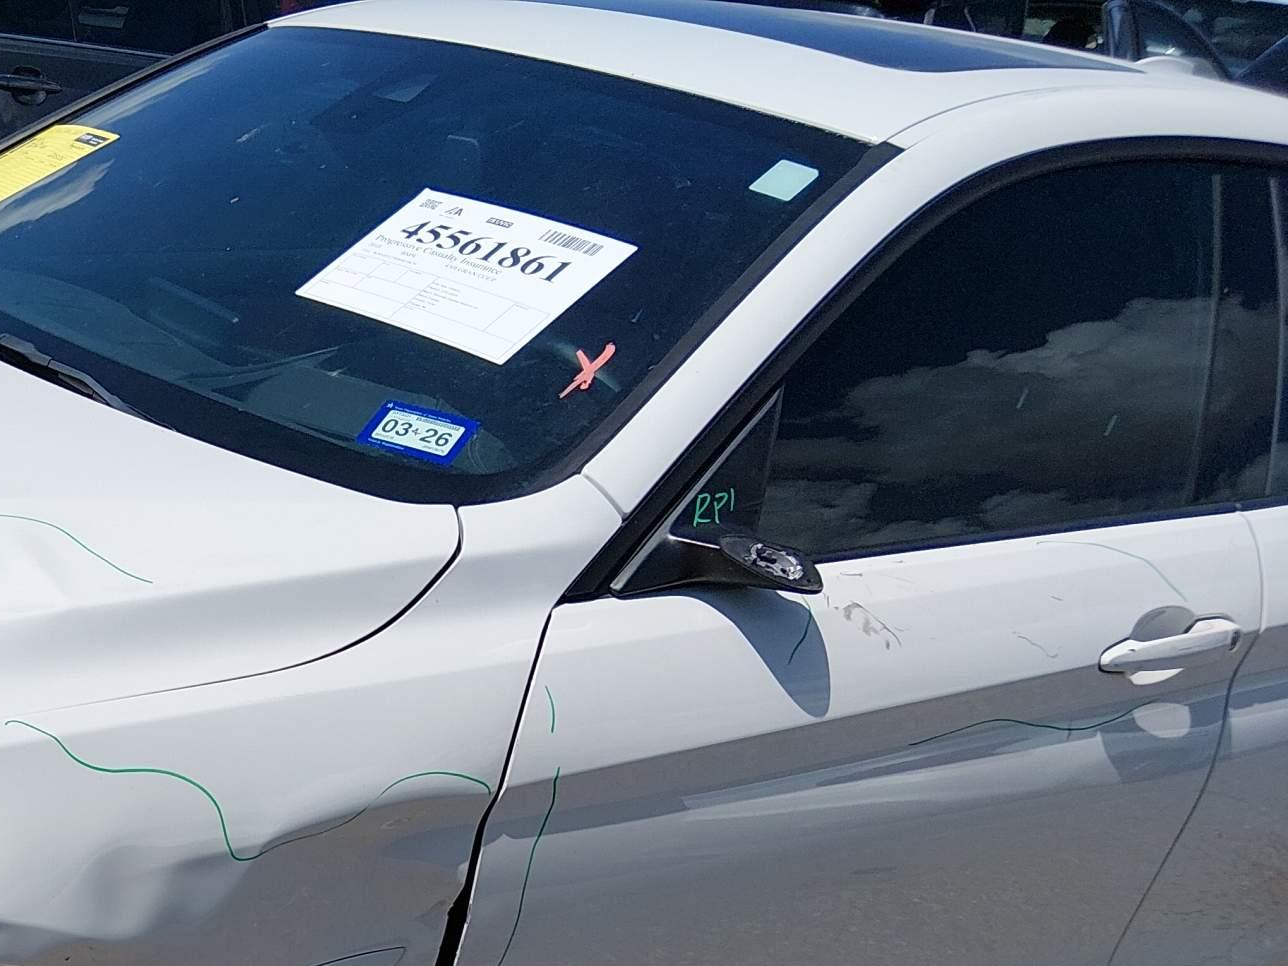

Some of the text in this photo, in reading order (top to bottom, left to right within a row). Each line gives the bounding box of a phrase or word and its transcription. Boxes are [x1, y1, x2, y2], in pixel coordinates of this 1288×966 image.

[375, 234, 423, 253] Progressive
[423, 247, 458, 263] Casualty
[460, 257, 502, 275] Insurance
[400, 220, 573, 284] 45561861
[381, 418, 412, 437] 03
[419, 428, 452, 447] 26
